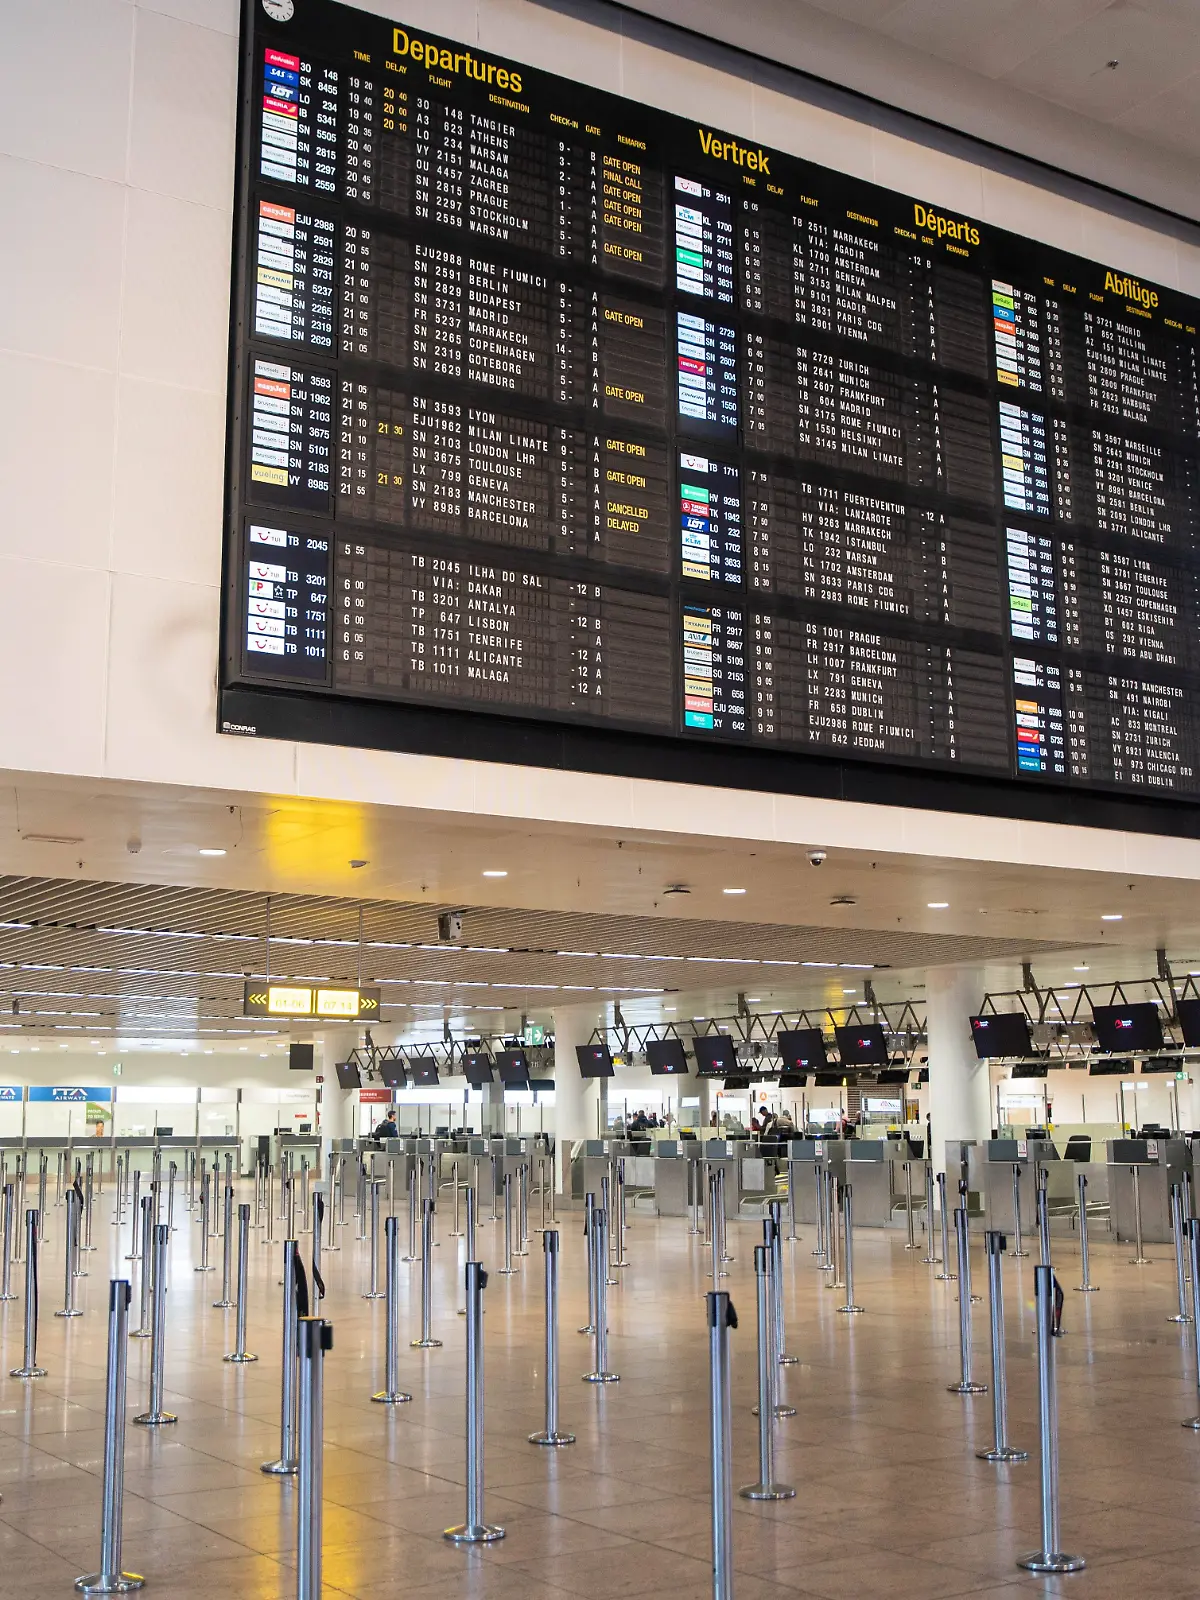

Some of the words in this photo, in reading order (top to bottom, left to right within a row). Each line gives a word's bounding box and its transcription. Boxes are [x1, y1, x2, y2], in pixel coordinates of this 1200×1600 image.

[393, 28, 522, 93] Departures
[269, 68, 285, 78] SAS
[270, 84, 293, 99] LOT
[354, 50, 370, 62] TIME
[386, 61, 407, 74] DELAY
[429, 75, 452, 88] FLIGHT
[489, 94, 529, 113] DESTINATION
[550, 114, 578, 128] CHECK-IN
[586, 125, 600, 136] GATE
[618, 134, 646, 150] REMARKS
[266, 99, 288, 110] IBERIA
[417, 128, 429, 140] LO
[444, 137, 462, 150] 234
[470, 144, 508, 164] WARSAW
[444, 107, 462, 120] 148
[470, 114, 514, 136] TANGIER
[604, 156, 620, 169] GATE
[622, 162, 640, 175] OPEN
[417, 114, 429, 125] A3
[444, 122, 462, 135] 623
[470, 130, 508, 149] ATHENS
[604, 170, 623, 184] FINAL
[625, 176, 642, 190] CALL
[699, 129, 770, 175] Vertrek
[416, 144, 429, 155] VY
[437, 150, 461, 165] 2151
[470, 159, 508, 179] MALAGA
[416, 159, 429, 171] OU
[437, 166, 462, 180] 4457
[471, 175, 508, 194] ZAGREB
[416, 175, 428, 186] SN
[436, 180, 462, 196] 2815
[470, 190, 508, 209] PRAGUE
[702, 188, 710, 197] TB
[716, 192, 730, 204] 2511
[262, 206, 291, 219] easyJet
[470, 205, 528, 230] STOCKHOLM
[743, 176, 756, 186] TIME
[767, 184, 784, 195] DELAY
[800, 195, 818, 206] FLIGHT
[847, 211, 878, 227] DESTINATION
[894, 227, 916, 240] CHECK-IN
[922, 236, 934, 246] GATE
[946, 244, 969, 257] REMARKS
[470, 220, 508, 240] WARSAW
[914, 204, 980, 246] Départs
[833, 230, 878, 251] MARRAKECH
[834, 244, 864, 260] AGADIR
[416, 245, 462, 266] EJU2988
[470, 259, 495, 274] ROME
[503, 268, 546, 288] FIUMICI
[835, 257, 880, 278] AMSTERDAM
[262, 274, 291, 285] RYANAIR
[469, 274, 508, 294] BERLIN
[836, 270, 865, 286] GENEVA
[836, 284, 861, 299] MILAN
[866, 293, 896, 309] MALPEN
[1044, 277, 1054, 286] TIME
[1126, 305, 1152, 319] DESTINATION
[1104, 271, 1159, 309] Abflüge
[469, 290, 521, 312] BUDAPEST
[836, 298, 866, 314] AGADIR
[469, 306, 508, 324] MADRID
[837, 311, 862, 326] PARIS
[868, 320, 882, 332] CDG
[469, 322, 528, 344] MARRAKECH
[837, 324, 868, 341] VIENNA
[470, 338, 534, 362] COPENHAGEN
[469, 354, 521, 374] GOTEBORG
[839, 359, 869, 375] ZURICH
[469, 369, 514, 388] HAMBURG
[839, 373, 869, 389] MUNICH
[1120, 372, 1144, 386] PRAGUE
[840, 387, 884, 406] FRANKFURT
[1122, 384, 1156, 401] FRANKFURT
[469, 409, 494, 424] LYON
[840, 401, 870, 416] MADRID
[841, 415, 861, 428] ROME
[867, 422, 900, 438] FIUMICI
[469, 425, 502, 442] MILAN
[510, 434, 548, 452] LINATE
[841, 429, 880, 446] HELSINKI
[469, 442, 508, 459] LONDON
[517, 452, 534, 465] LHR
[842, 443, 868, 458] MILAN
[873, 451, 902, 466] LINATE
[254, 468, 284, 483] vueling
[469, 458, 521, 478] TOULOUSE
[1127, 465, 1163, 481] STOCKHOLM
[1128, 478, 1152, 490] VENICE
[469, 474, 508, 492] GENEVA
[608, 502, 648, 518] CANCELLED
[844, 493, 905, 514] FUERTEVENTUR
[468, 490, 535, 513] MANCHESTER
[607, 518, 639, 532] DELAYED
[468, 507, 528, 528] BARCELONA
[845, 507, 890, 526] LANZAROTE
[845, 522, 891, 540] MARRAKECH
[1131, 516, 1155, 528] LONDON
[1159, 522, 1171, 532] LHR
[1132, 528, 1164, 543] ALICANTE
[847, 536, 886, 553] ISTANBUL
[846, 551, 876, 565] WARSAW
[470, 565, 494, 579] ILHA
[502, 571, 515, 582] DO
[523, 575, 542, 587] SAL
[847, 566, 893, 582] AMSTERDAM
[1135, 572, 1167, 587] TENERIFE
[468, 582, 501, 597] DAKAR
[848, 580, 873, 593] PARIS
[878, 586, 893, 597] CDG
[1136, 585, 1168, 600] TOULOUSE
[468, 599, 515, 616] ANTALYA
[848, 595, 868, 606] ROME
[874, 600, 908, 614] FIUMICI
[1136, 598, 1176, 614] COPENHAGEN
[469, 616, 508, 632] LISBON
[469, 633, 522, 650] TENERIFE
[850, 631, 880, 645] PRAGUE
[1139, 638, 1164, 649] VIENNA
[468, 650, 522, 667] ALICANTE
[850, 646, 896, 662] BARCELONA
[1140, 650, 1152, 660] ABU
[1156, 653, 1176, 664] DHABI
[468, 667, 508, 682] MALAGA
[851, 661, 896, 677] FRANKFURT
[851, 676, 882, 690] GENEVA
[1142, 682, 1182, 697] MANCHESTER
[851, 691, 882, 704] MUNICH
[852, 706, 883, 719] DUBLIN
[1144, 709, 1168, 720] KIGALI
[231, 724, 256, 732] CONRAC
[852, 721, 873, 732] ROME
[880, 725, 914, 738] FIUMICI
[854, 736, 884, 749] JEDDAH
[1146, 749, 1179, 761] VALENCIA
[1148, 762, 1176, 774] CHICAGO
[1180, 767, 1192, 776] ORD
[1148, 776, 1172, 786] DUBLIN
[52, 1088, 88, 1096] ITA
